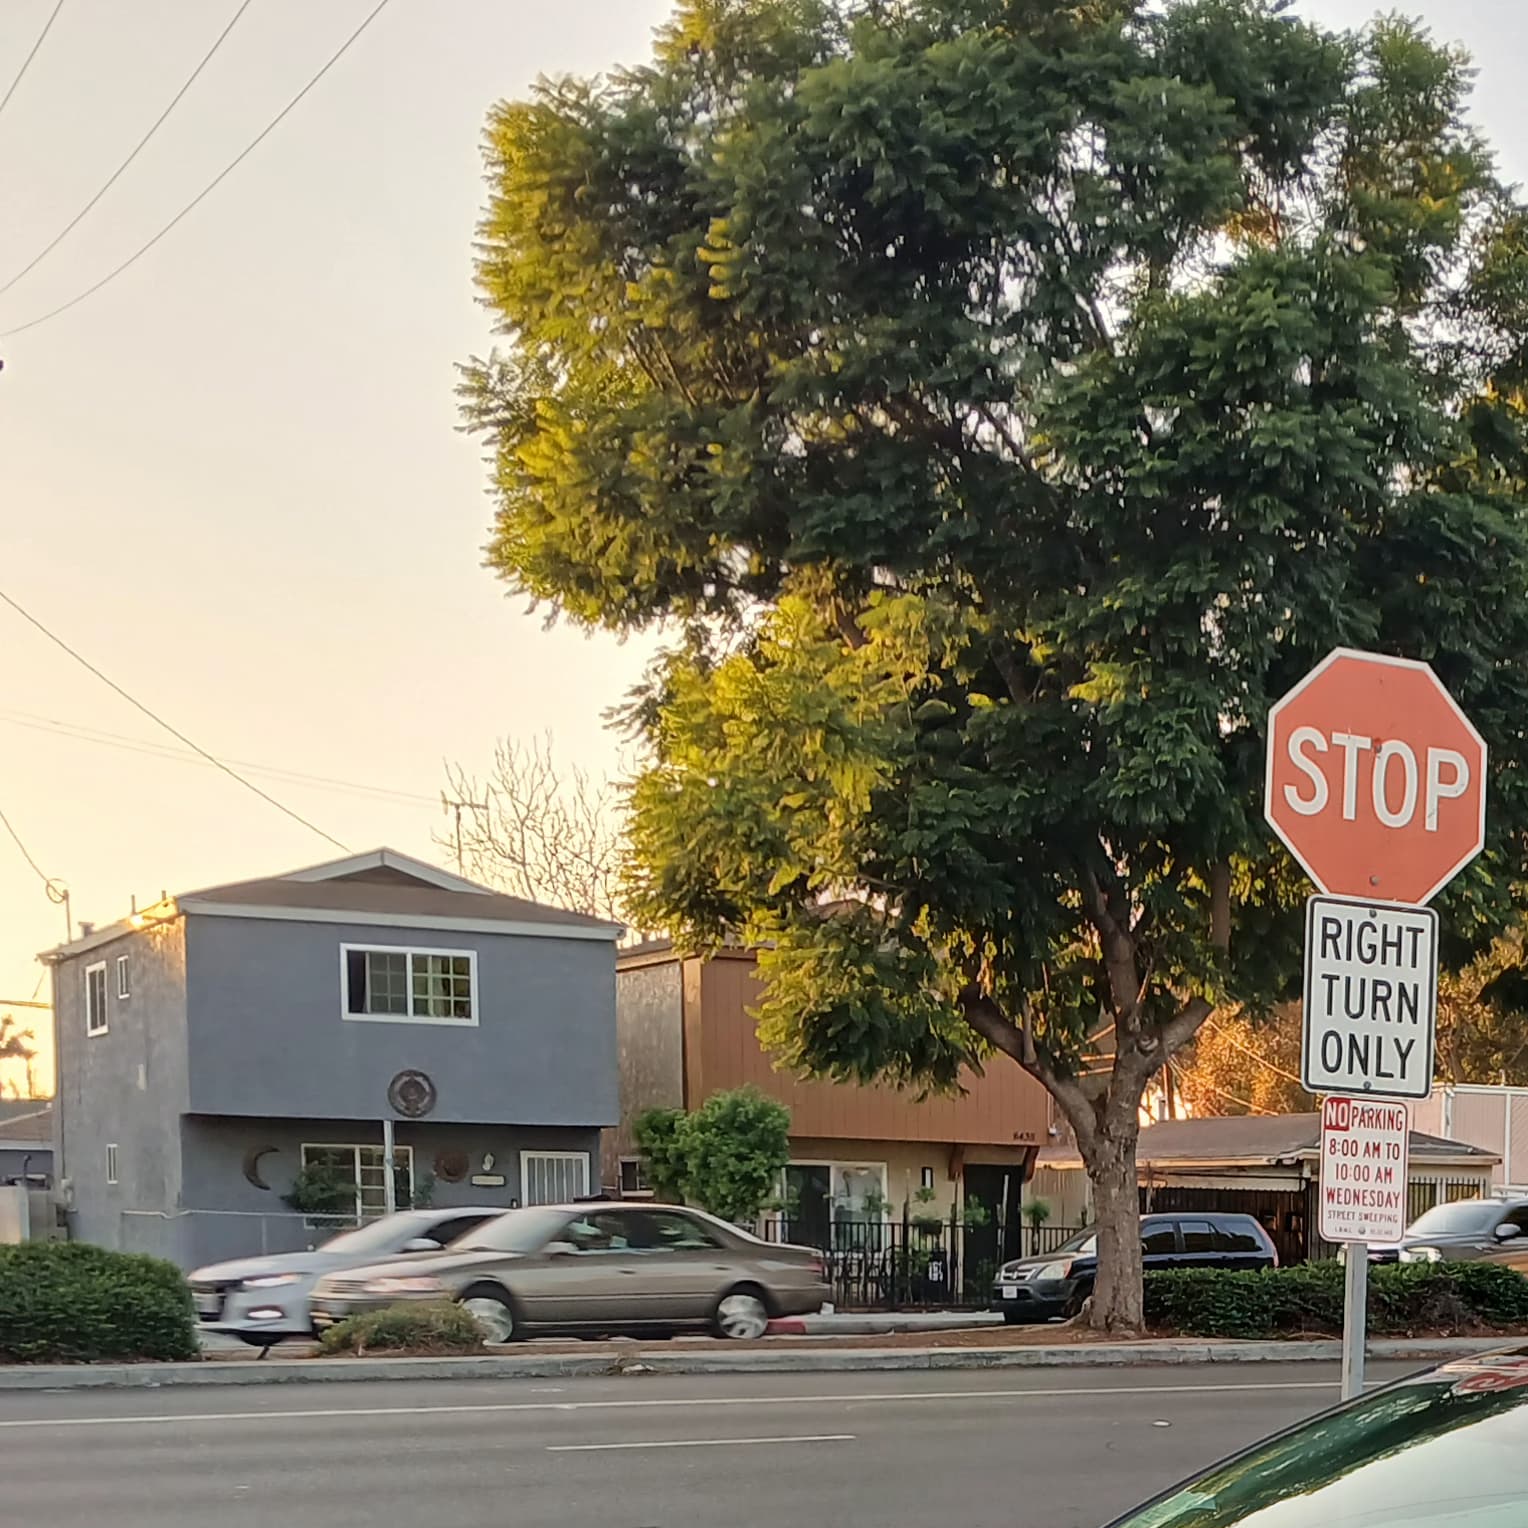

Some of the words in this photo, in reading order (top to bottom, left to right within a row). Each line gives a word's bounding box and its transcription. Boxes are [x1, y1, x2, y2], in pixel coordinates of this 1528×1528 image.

[1283, 726, 1470, 832] STOP
[1321, 917, 1424, 969] RIGHT
[1321, 974, 1420, 1025] TURN
[1321, 1030, 1416, 1080] ONLY
[1325, 1102, 1348, 1128] NO
[1351, 1106, 1403, 1132] PARKING
[1329, 1138, 1359, 1158] 8:00
[1363, 1142, 1381, 1159] AM
[1386, 1143, 1401, 1161] TO
[1336, 1163, 1370, 1182] 10:00
[1375, 1166, 1393, 1184] AM
[1326, 1187, 1401, 1209] WEDNESDAY
[1327, 1209, 1355, 1221] STREET
[1358, 1211, 1398, 1224] SWEEPING
